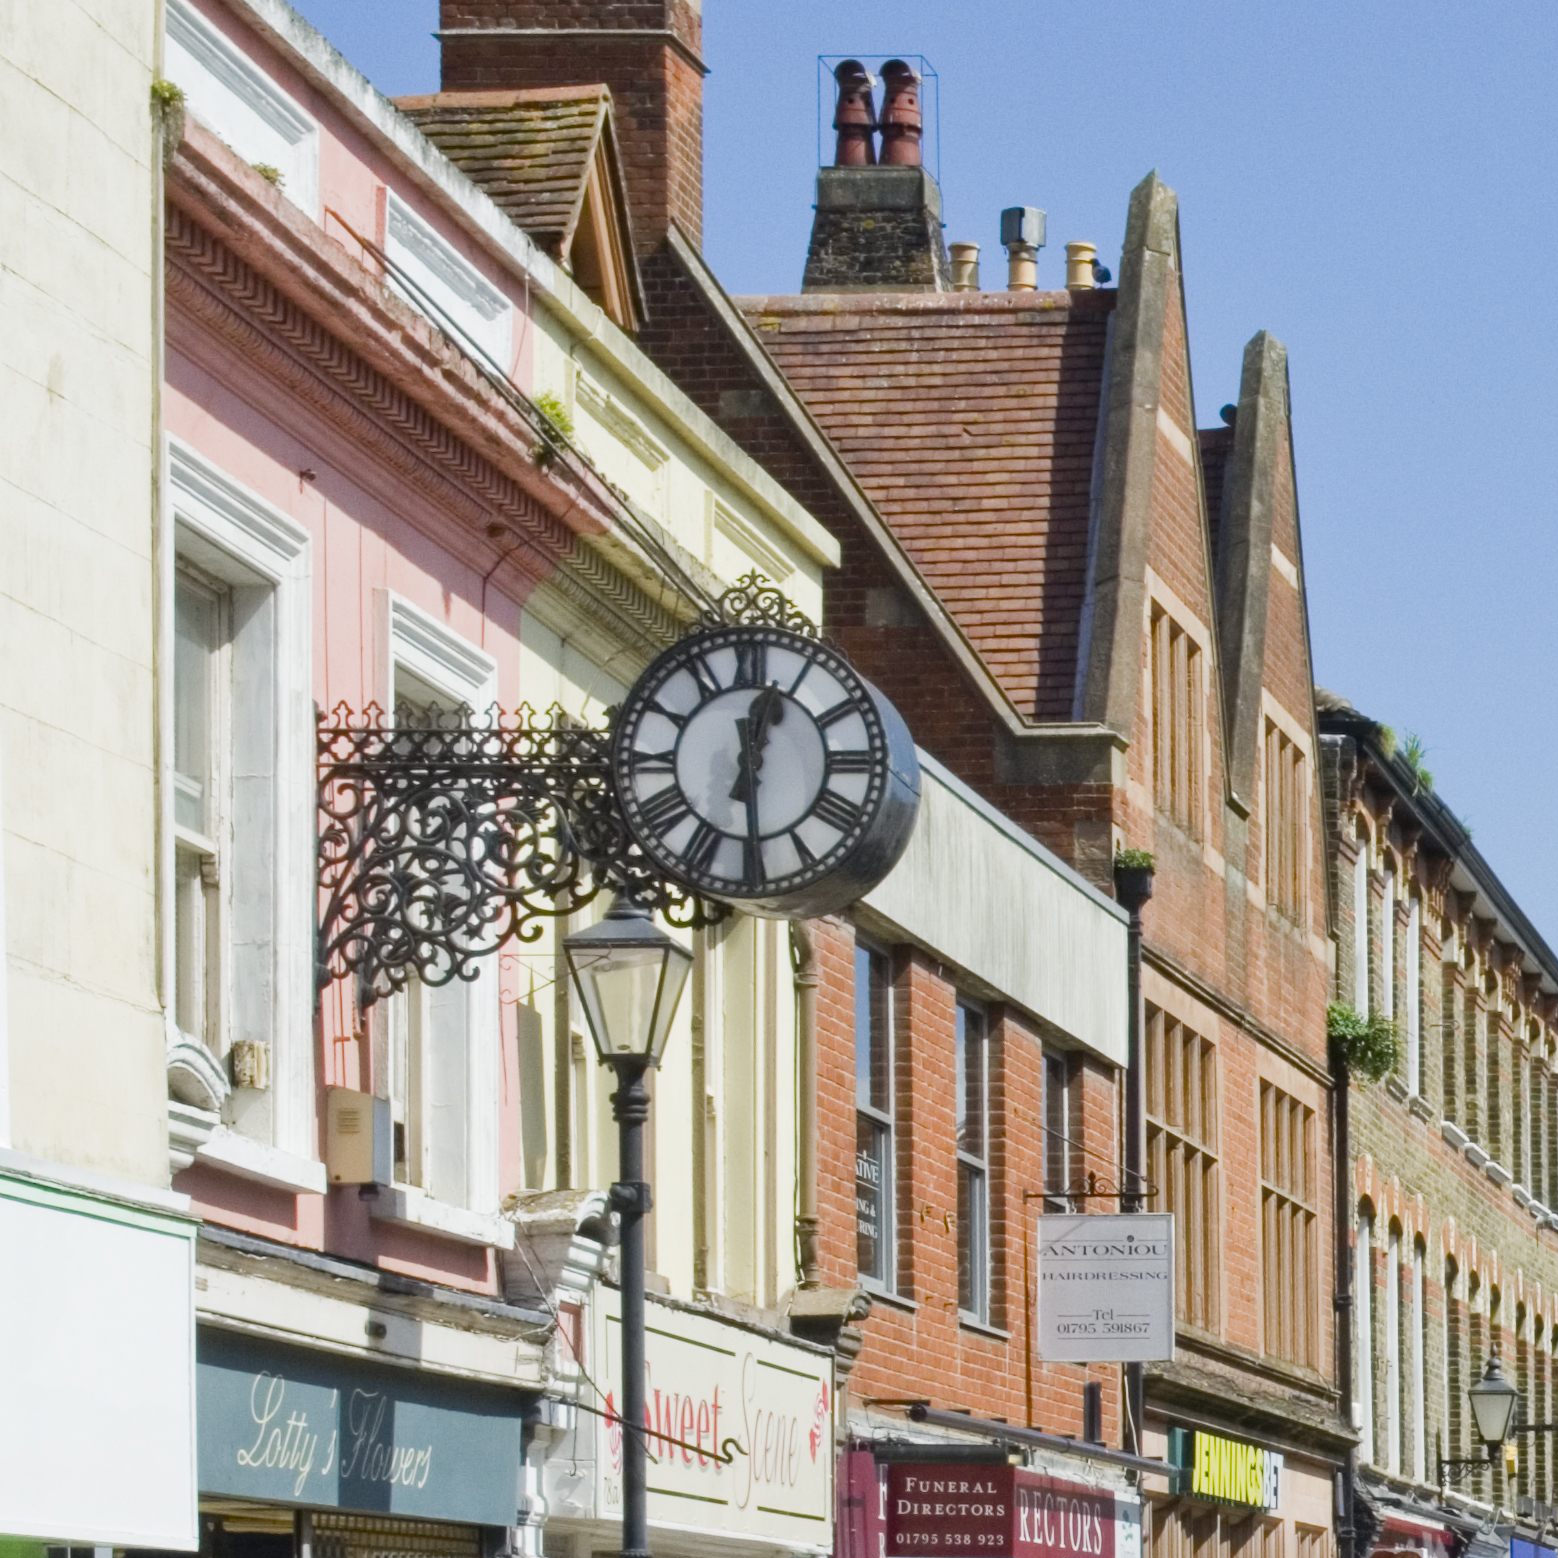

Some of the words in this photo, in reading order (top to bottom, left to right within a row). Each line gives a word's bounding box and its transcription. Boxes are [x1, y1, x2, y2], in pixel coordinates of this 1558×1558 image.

[1042, 1271, 1168, 1281] HAIRDRESSING
[1092, 1308, 1114, 1321] Tel
[1057, 1322, 1097, 1335] 01795
[1102, 1322, 1151, 1334] 591867
[237, 1369, 338, 1497] Lotty's
[340, 1387, 433, 1489] Flowers
[644, 1360, 723, 1471] weet
[732, 1352, 802, 1509] Scene
[1015, 1484, 1103, 1556] RECTORS
[896, 1532, 939, 1545] 01795
[945, 1533, 972, 1545] 538
[977, 1534, 1005, 1546] 923
